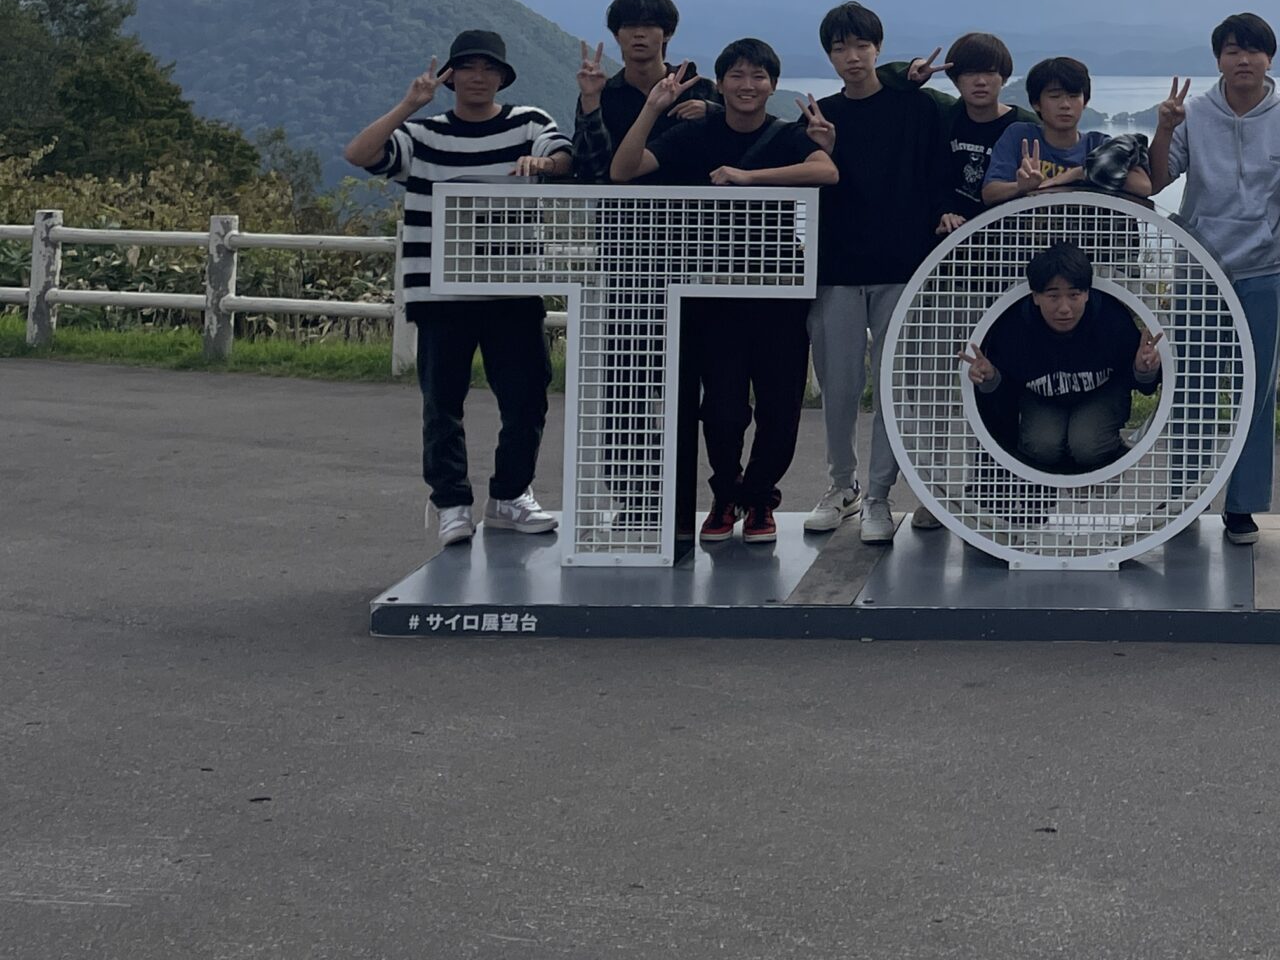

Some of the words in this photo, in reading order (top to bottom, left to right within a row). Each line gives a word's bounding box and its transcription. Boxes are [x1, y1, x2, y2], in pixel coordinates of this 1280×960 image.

[426, 613, 538, 632] サイロ展望台
